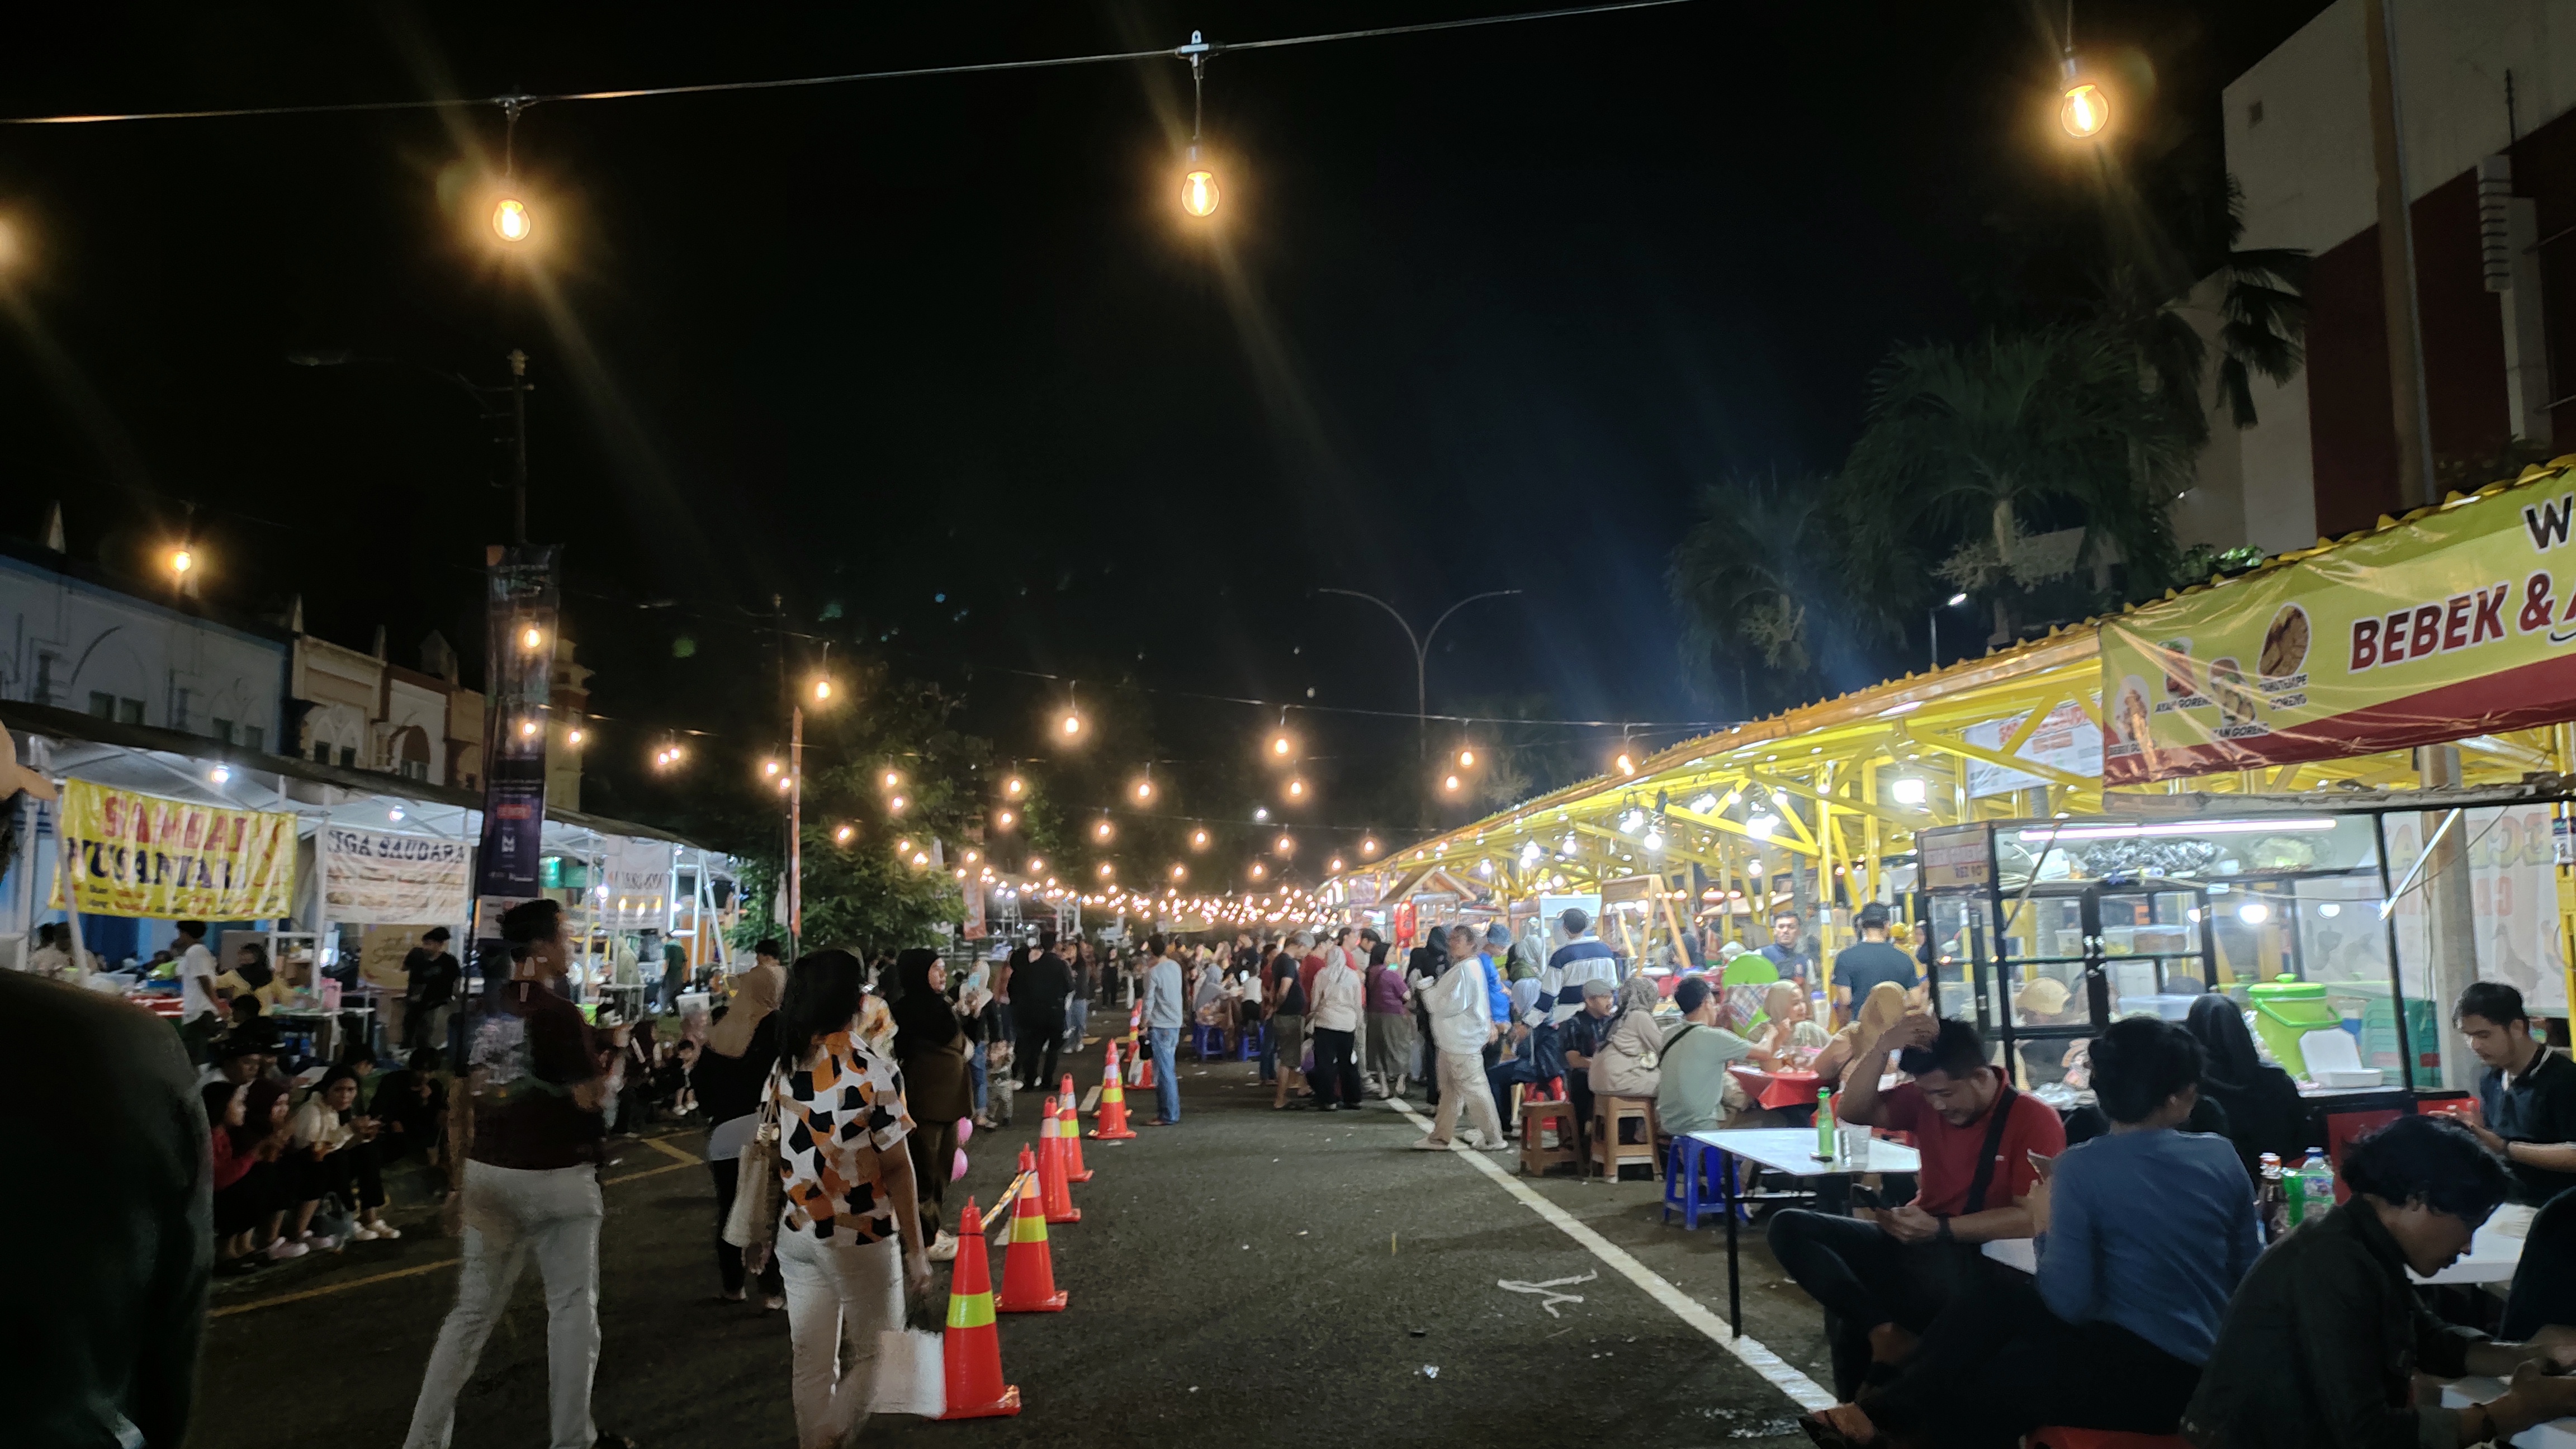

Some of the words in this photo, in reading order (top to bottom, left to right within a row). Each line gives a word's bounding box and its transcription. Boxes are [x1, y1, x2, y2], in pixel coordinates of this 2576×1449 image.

[2350, 583, 2509, 671] BEBEK
[2519, 572, 2555, 631] &
[377, 836, 465, 864] SAUDARA
